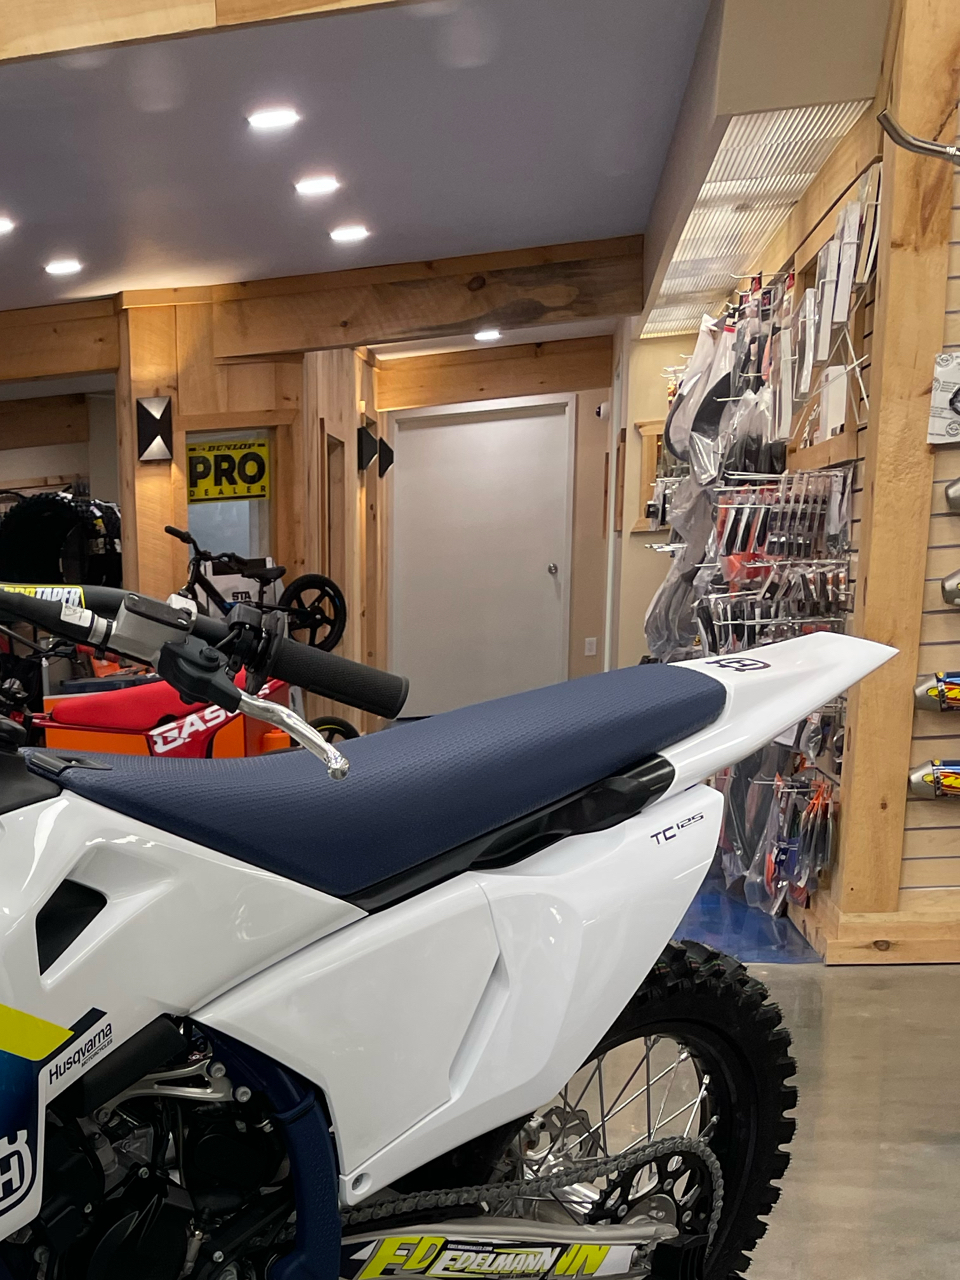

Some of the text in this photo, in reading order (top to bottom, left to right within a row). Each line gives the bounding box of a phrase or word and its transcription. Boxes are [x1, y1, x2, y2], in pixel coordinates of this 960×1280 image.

[207, 442, 257, 452] DUNLOP
[189, 451, 266, 487] PRO
[189, 485, 267, 497] DEALER
[650, 811, 704, 845] TC 125
[49, 1022, 112, 1085] Husqvarna
[81, 1038, 113, 1067] MOTORCYCLES
[426, 1246, 562, 1277] EDELMANN
